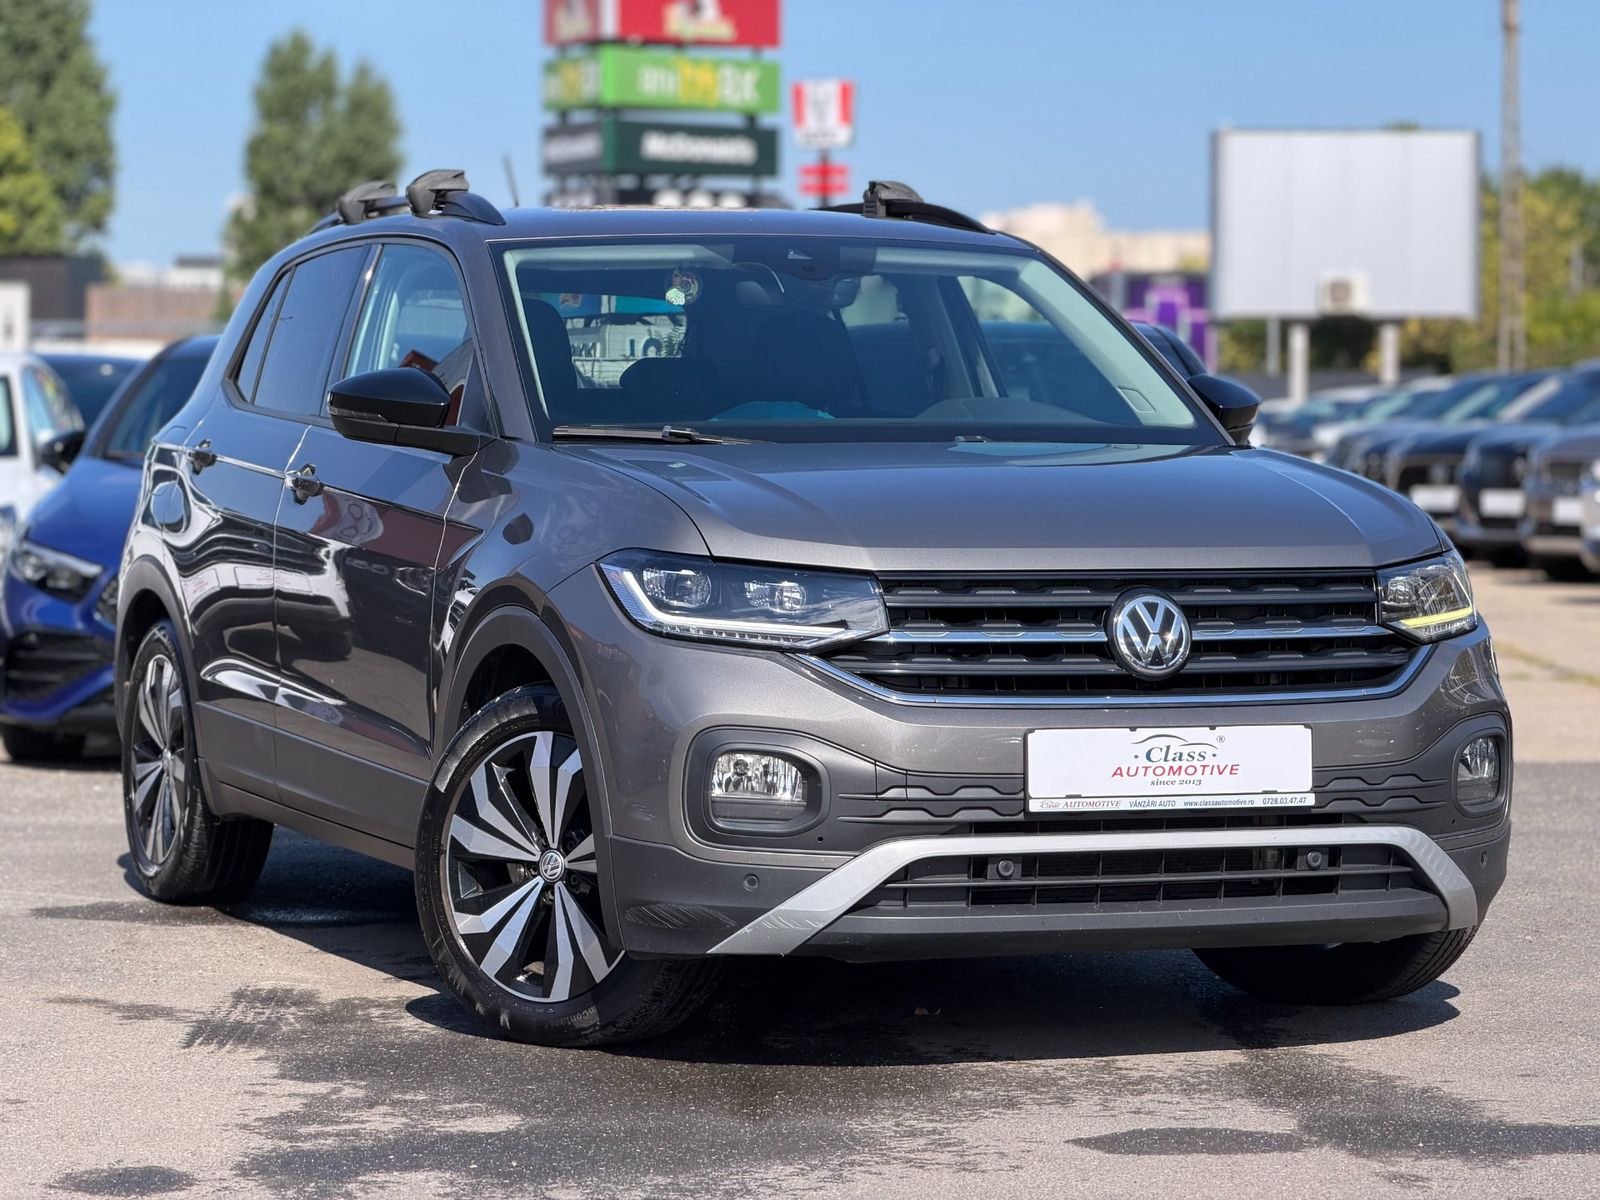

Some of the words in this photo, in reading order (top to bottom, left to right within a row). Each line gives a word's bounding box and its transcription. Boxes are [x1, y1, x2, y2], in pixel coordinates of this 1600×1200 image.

[1145, 745, 1207, 763] Class
[1112, 764, 1240, 778] AUTOMOTIVE
[1150, 778, 1176, 786] since
[1178, 778, 1202, 786] 2013
[1063, 799, 1121, 809] AUTOMOTIVE
[1158, 799, 1176, 808] AUTO
[1183, 798, 1255, 807] www.classautomotive.ro
[1262, 796, 1307, 806] 0728.03.47.47
